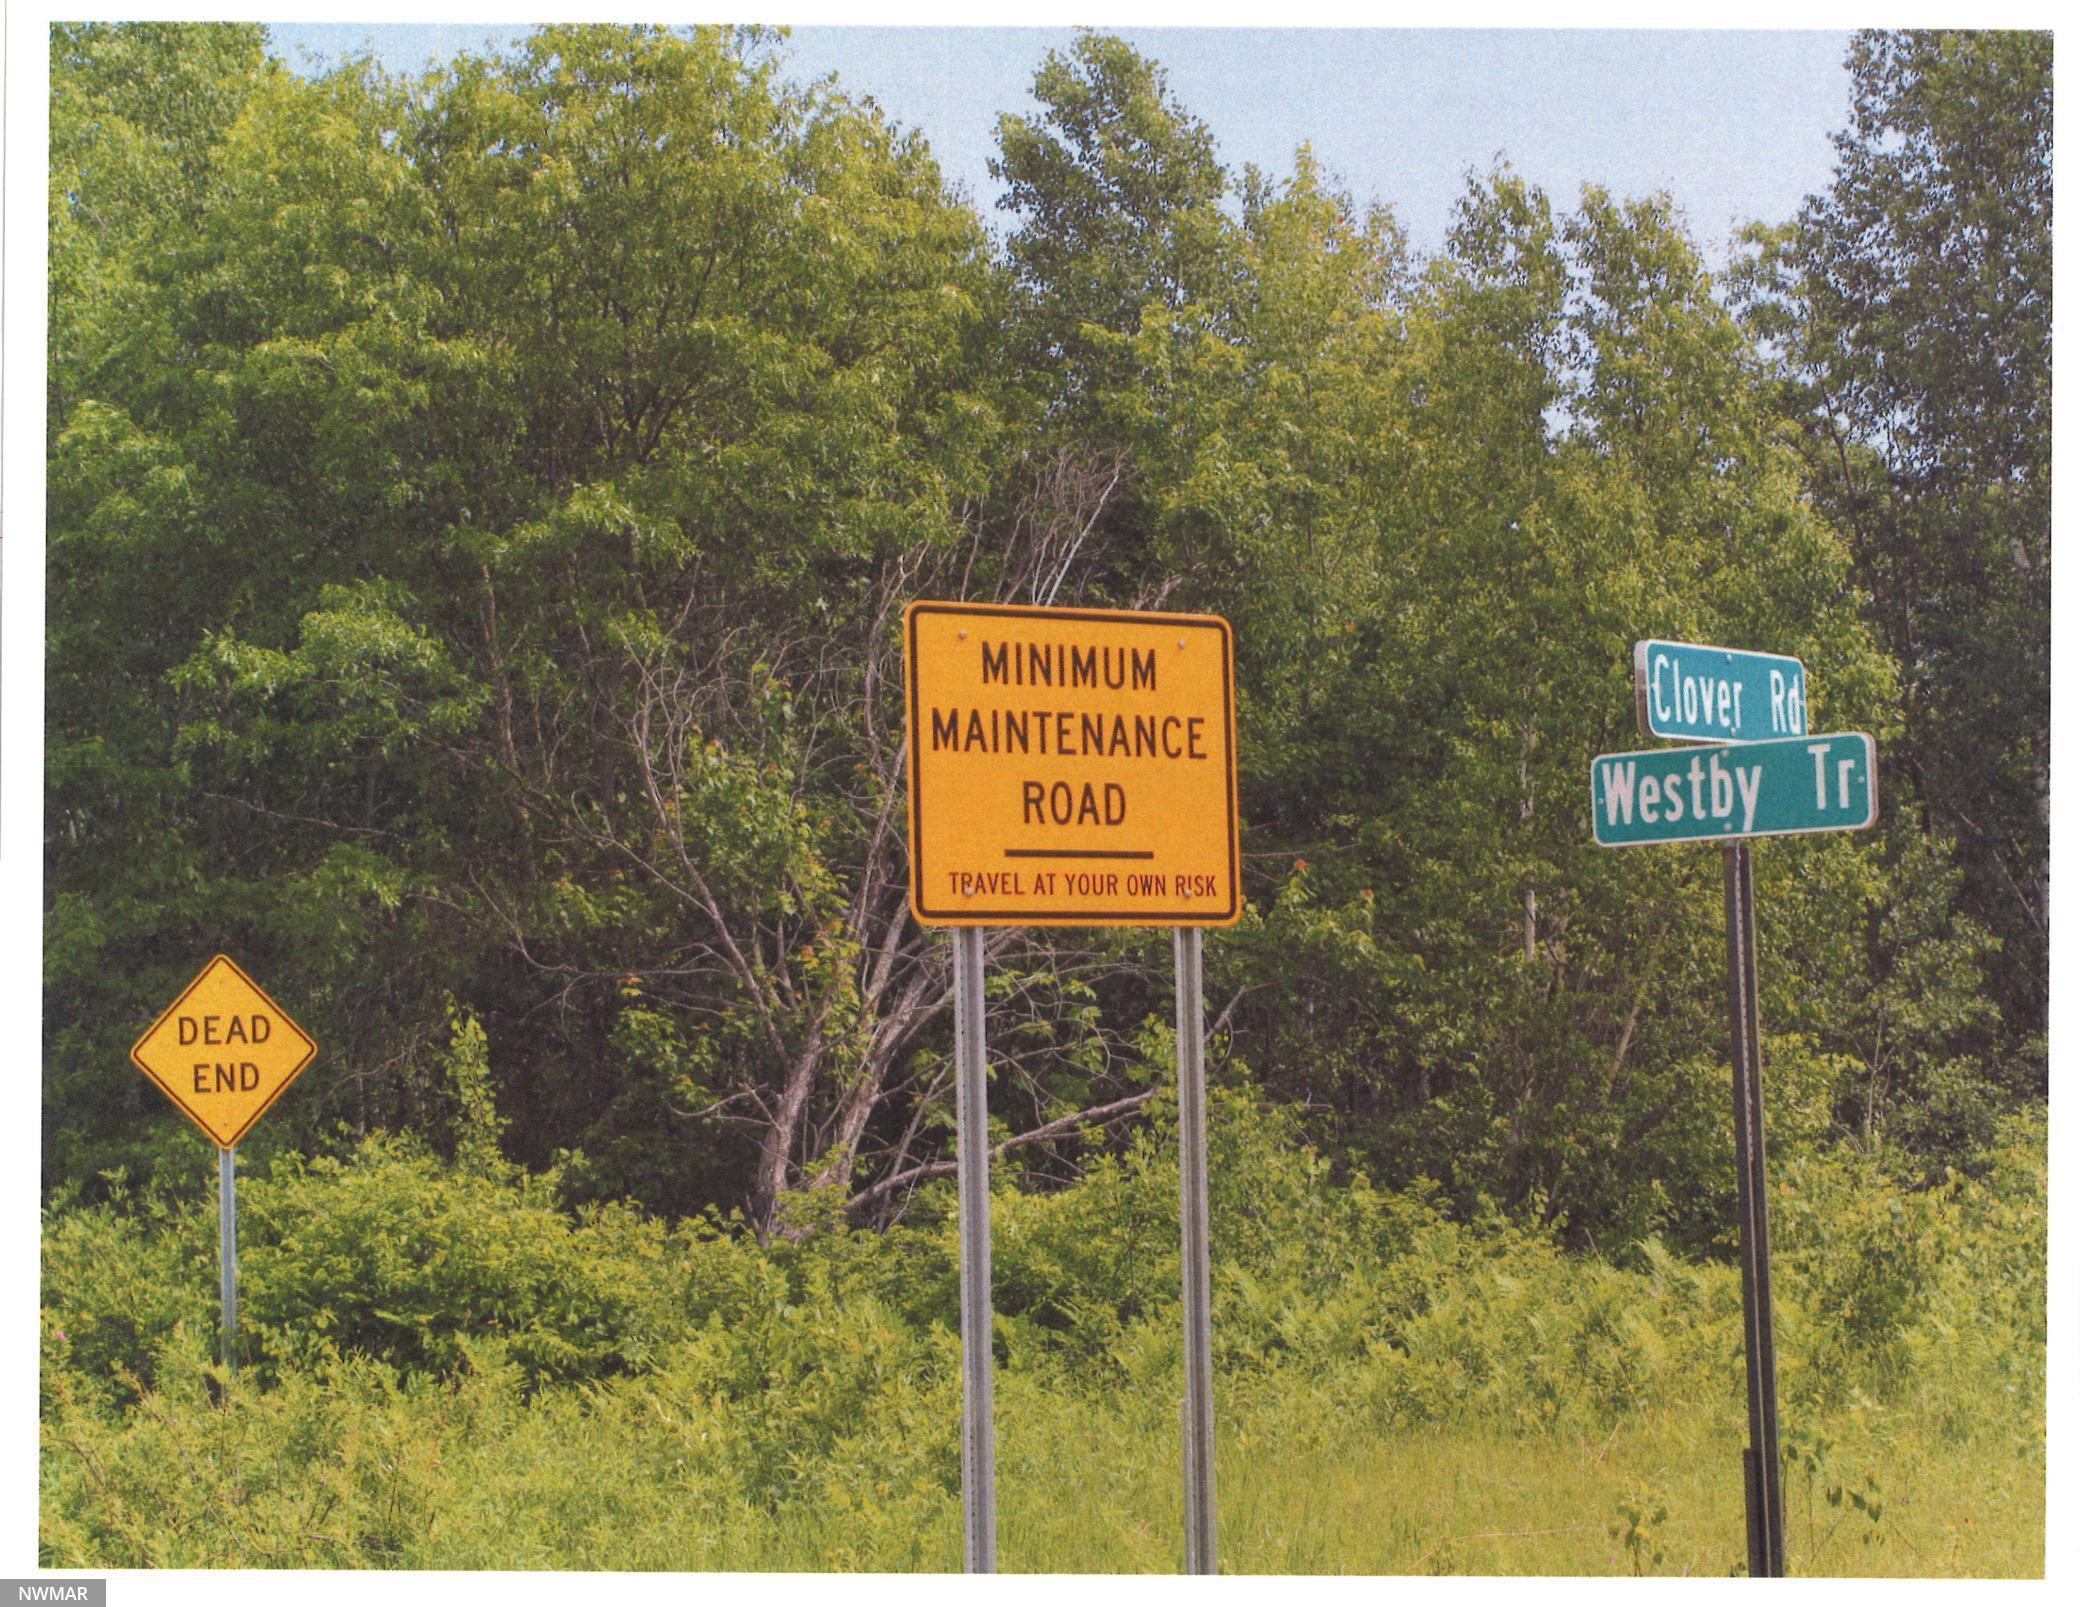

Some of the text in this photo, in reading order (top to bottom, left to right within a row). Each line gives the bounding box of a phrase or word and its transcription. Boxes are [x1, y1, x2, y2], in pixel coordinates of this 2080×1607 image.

[982, 640, 1157, 691] MINIMUM
[1653, 653, 1801, 735] Clover Rd
[931, 707, 1208, 760] MAINTENANCE
[1022, 780, 1127, 826] ROAD
[1601, 743, 1856, 833] Westby Tr
[949, 871, 1217, 897] TRAVEL AT YOUR OWN RISK
[178, 1014, 271, 1046] DEAD
[193, 1062, 260, 1094] END
